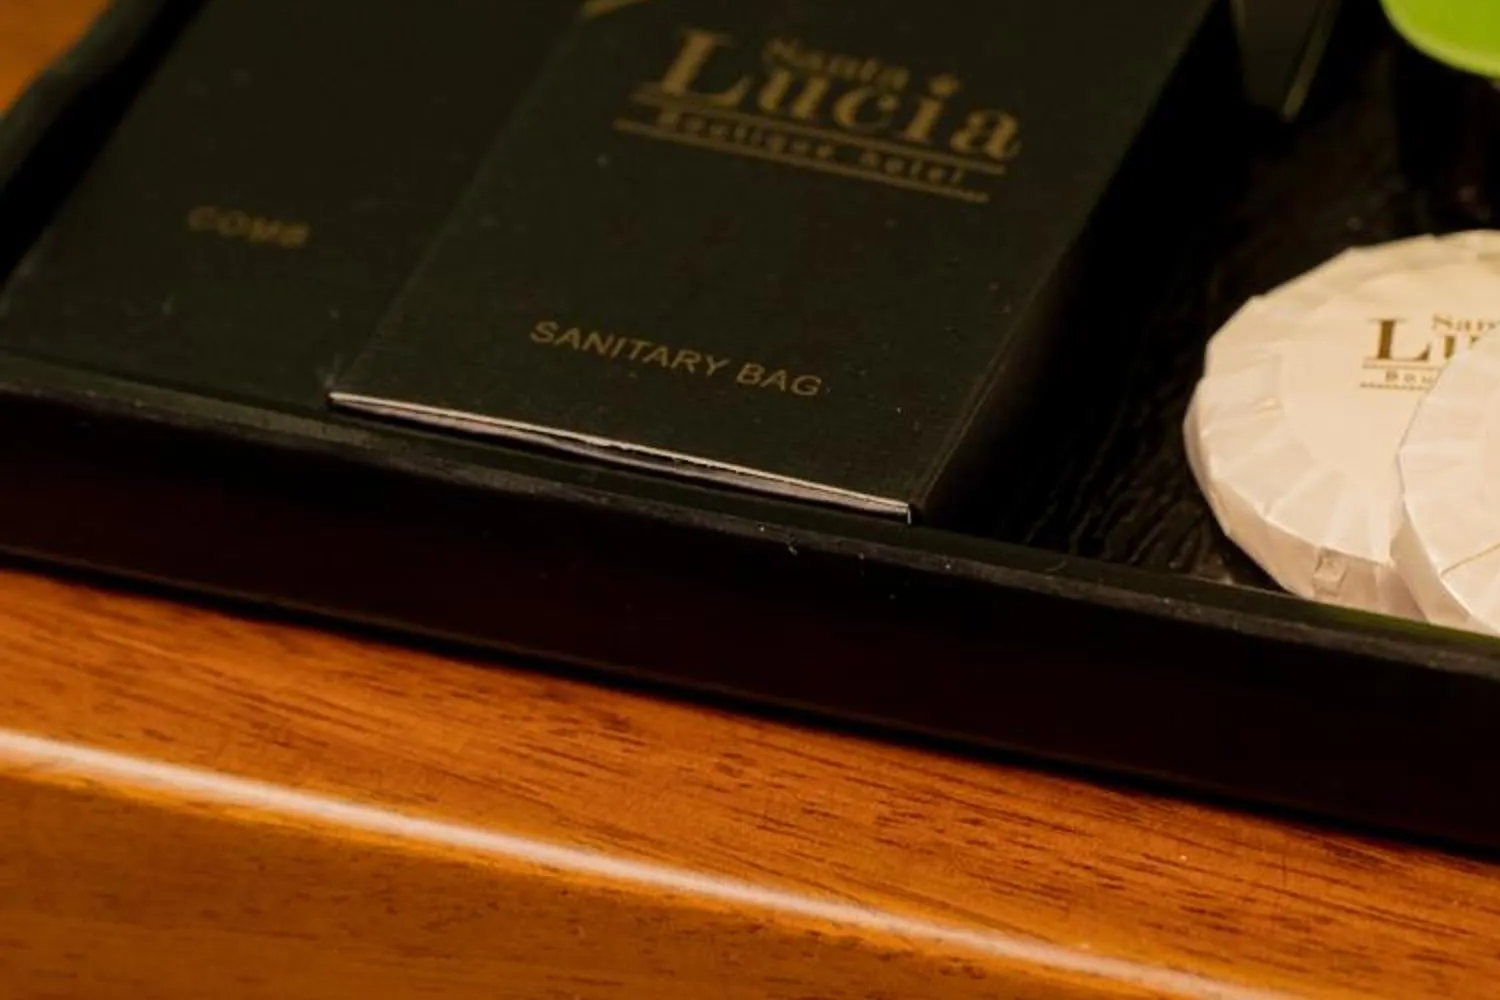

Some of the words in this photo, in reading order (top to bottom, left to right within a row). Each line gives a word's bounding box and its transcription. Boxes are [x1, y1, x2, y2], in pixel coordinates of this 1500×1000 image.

[640, 27, 1022, 160] Lucia
[530, 320, 731, 378] SANITARY
[736, 362, 823, 397] BAG
